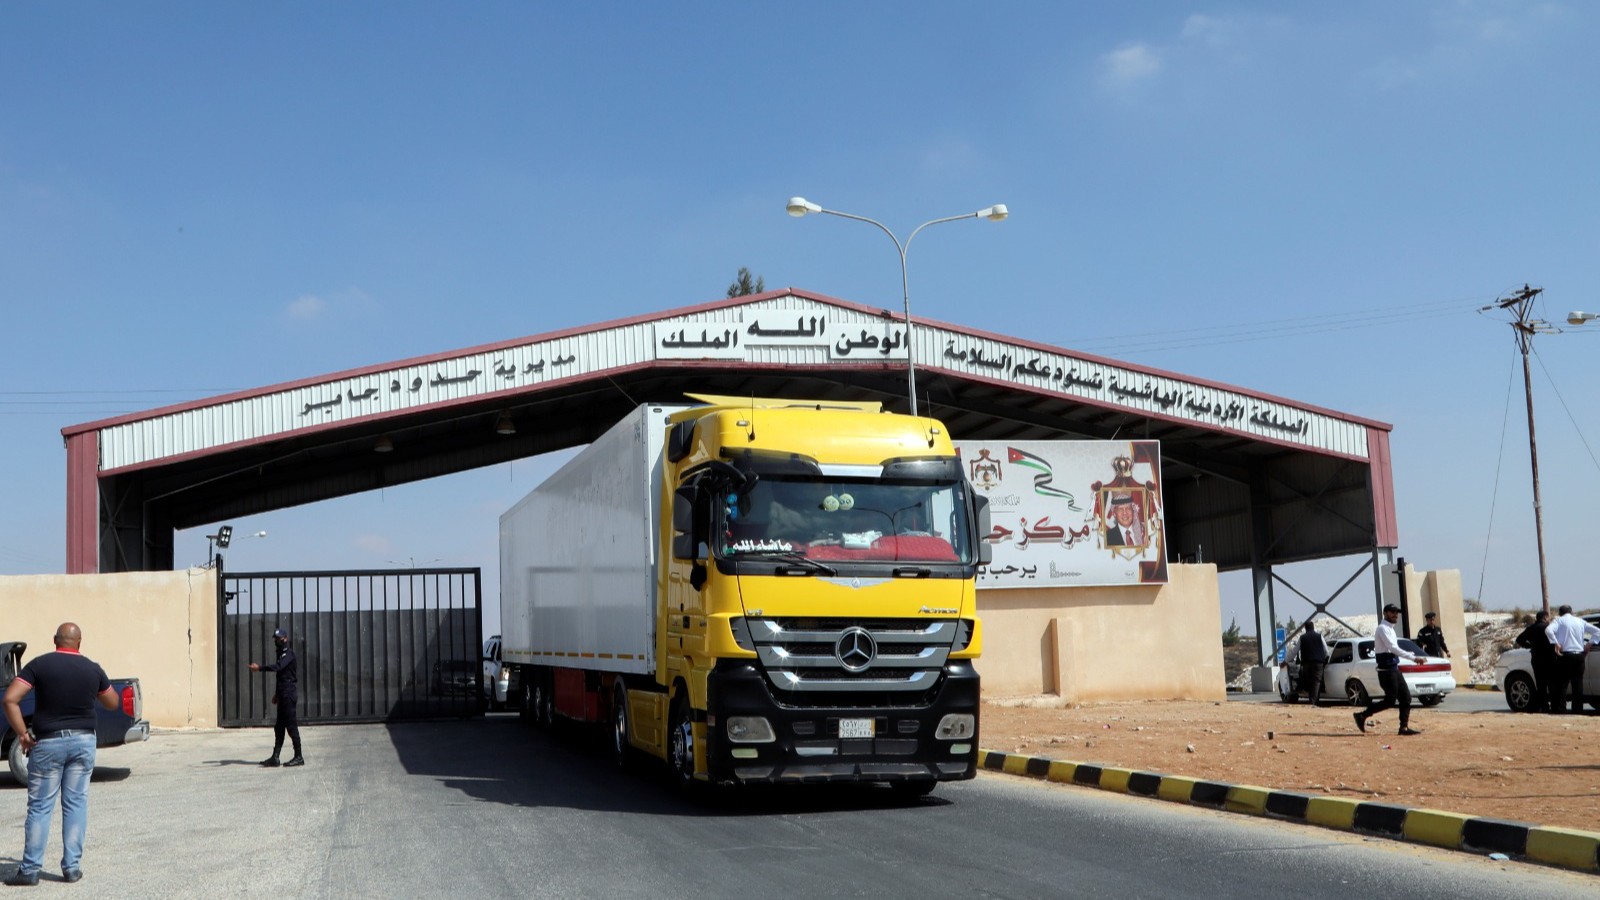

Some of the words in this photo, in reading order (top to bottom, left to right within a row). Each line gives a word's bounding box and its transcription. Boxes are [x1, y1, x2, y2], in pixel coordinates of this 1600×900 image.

[662, 328, 738, 349] الملك
[747, 314, 826, 338] الله
[836, 330, 908, 357] الوطن
[944, 340, 1012, 372] السلامة
[494, 355, 576, 380] مديرية
[391, 370, 482, 393] حدود
[1108, 374, 1183, 409] الهاشمية
[298, 388, 378, 415] جابر
[1185, 389, 1244, 422] الأردنية
[1249, 405, 1308, 437] المملكة
[732, 538, 755, 552] الله
[1015, 515, 1091, 550] مركز
[989, 564, 1038, 579] يرحب
